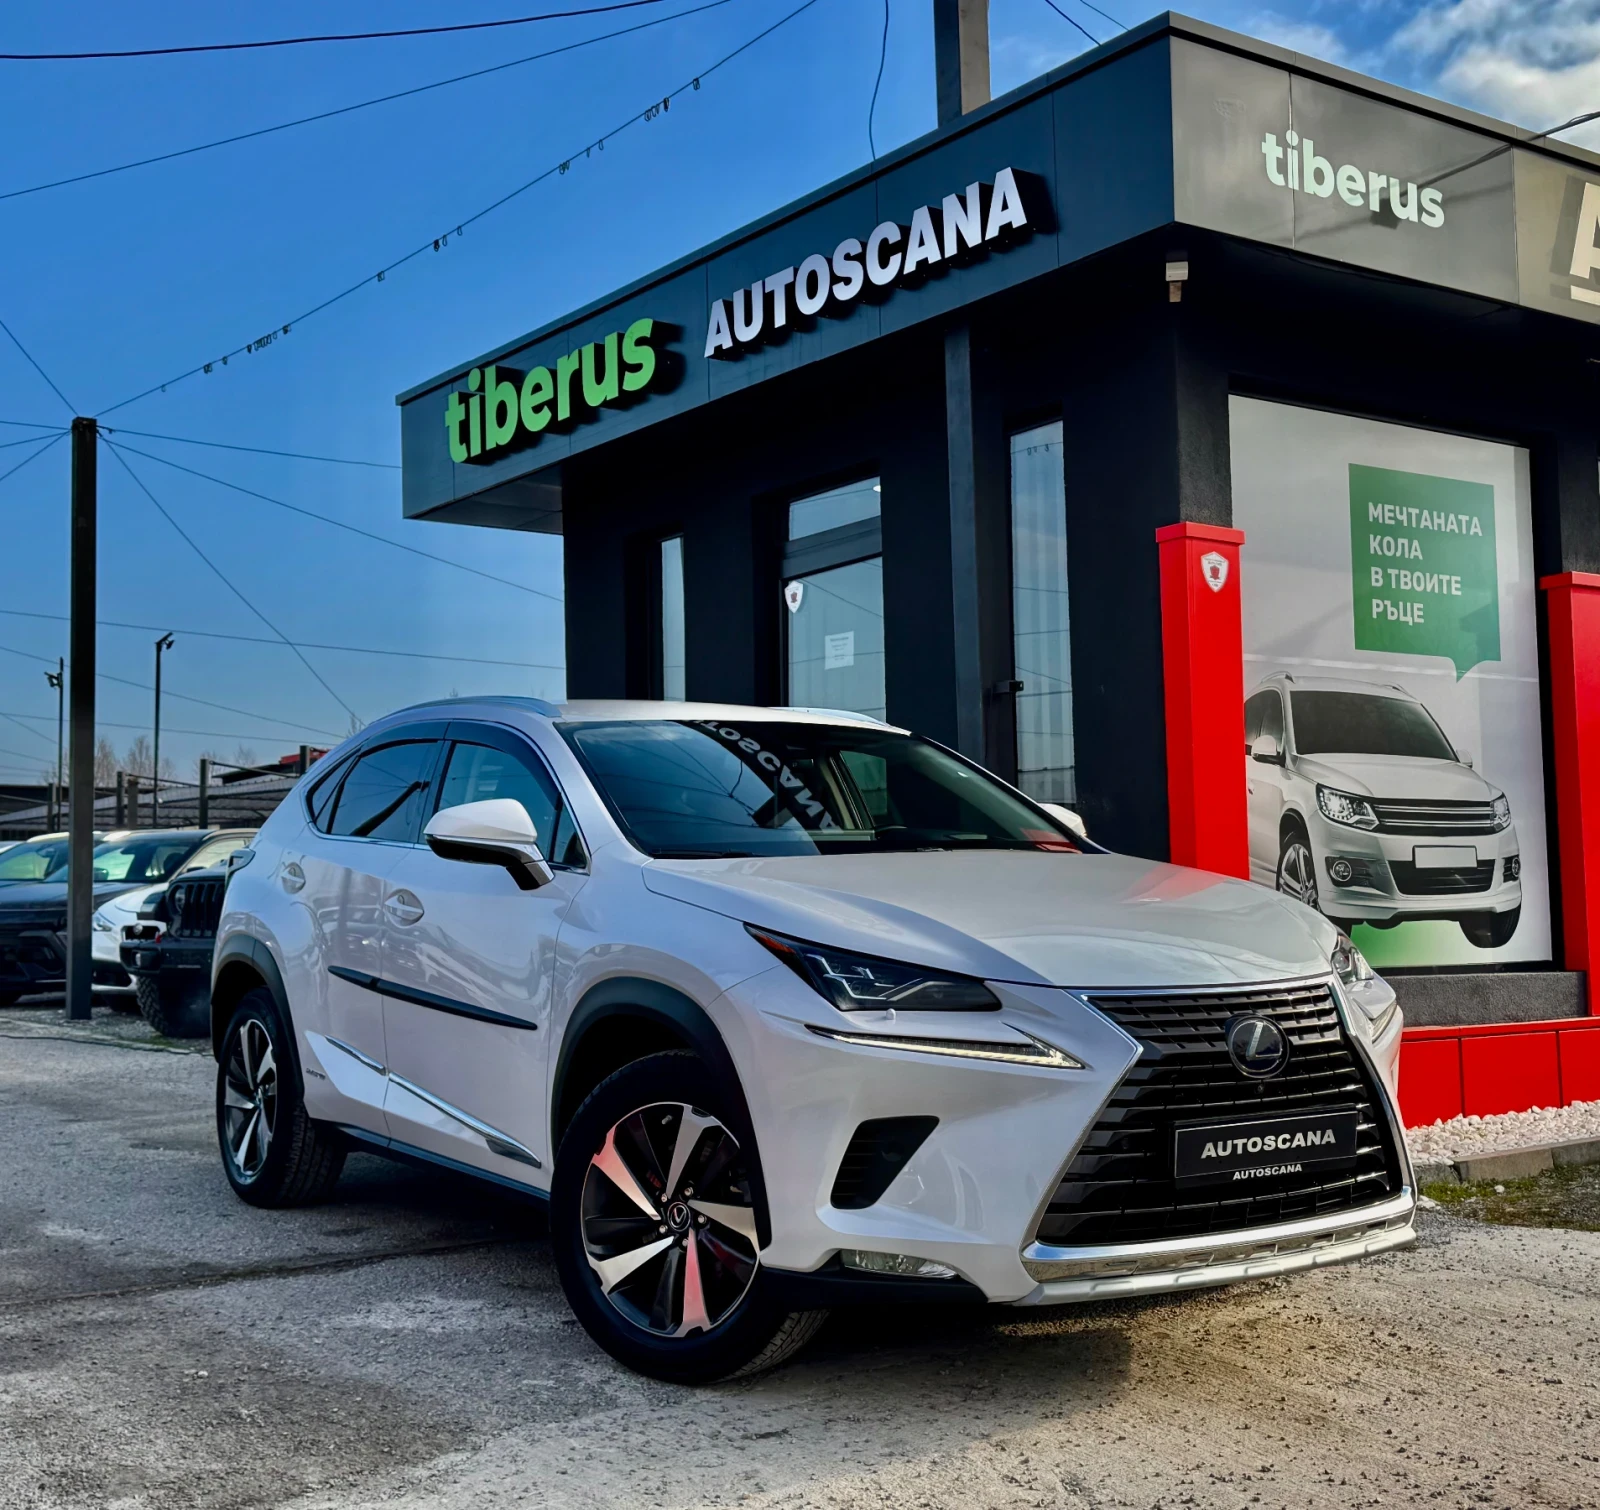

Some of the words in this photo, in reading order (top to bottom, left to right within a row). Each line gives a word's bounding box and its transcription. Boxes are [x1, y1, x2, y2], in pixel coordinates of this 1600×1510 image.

[1261, 129, 1445, 228] tiberus
[444, 317, 656, 463] tiberus
[704, 166, 1027, 358] AUTOSCANA
[1368, 501, 1483, 537] МЕЧТАНАТА
[1369, 533, 1423, 560] КОЛА
[1370, 566, 1383, 587] В
[1387, 568, 1462, 596] ТВОИТЕ
[1371, 598, 1425, 626] РЪЦЕ
[1200, 1129, 1336, 1159] AUTOSCANA
[1233, 1164, 1303, 1180] AUTOSCANA
